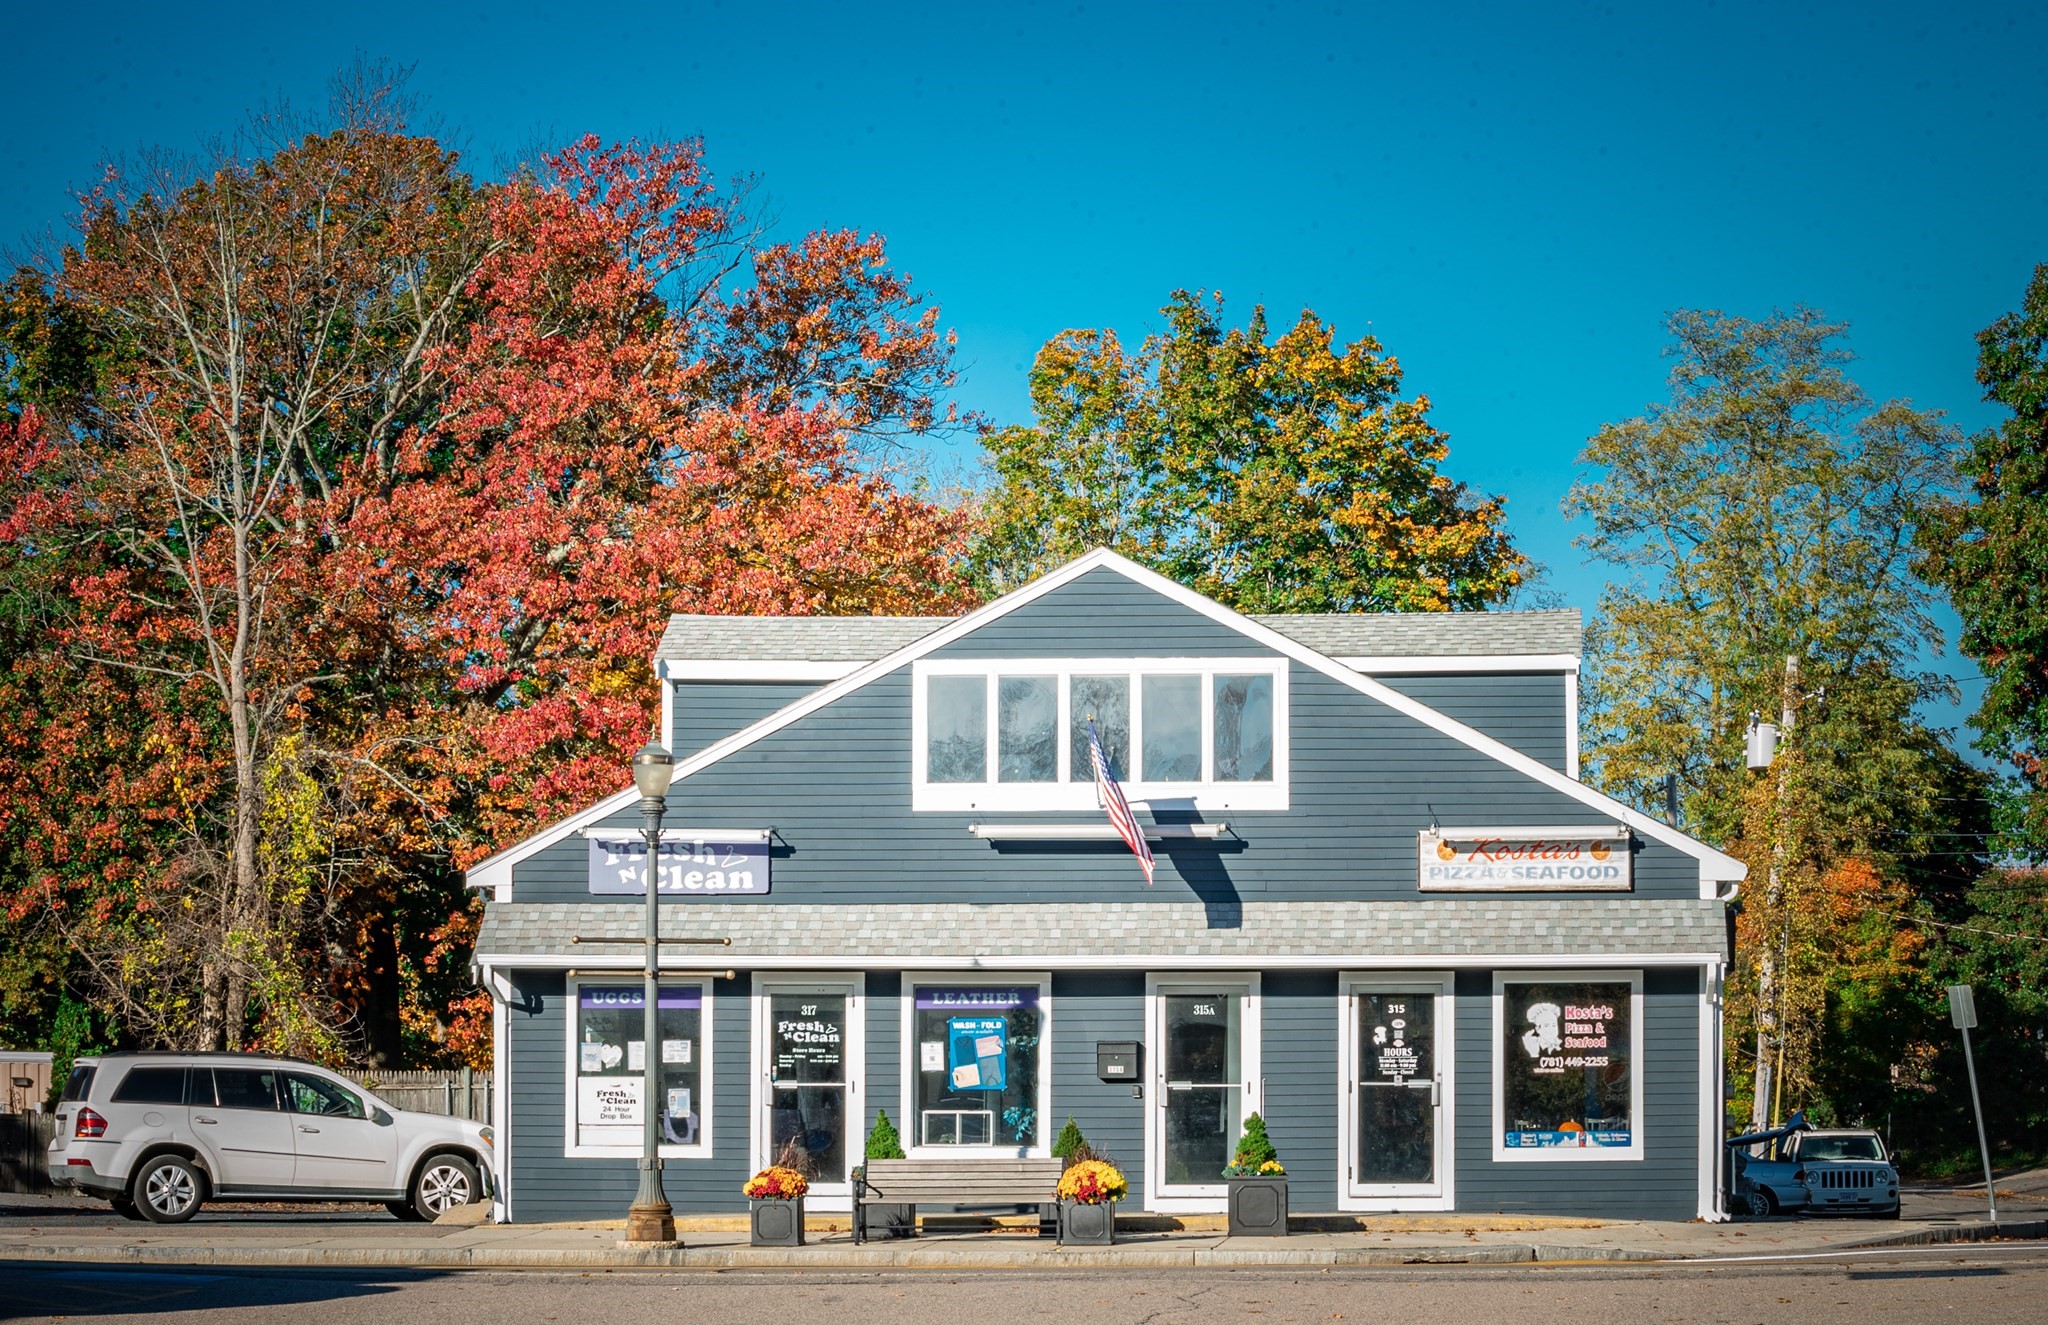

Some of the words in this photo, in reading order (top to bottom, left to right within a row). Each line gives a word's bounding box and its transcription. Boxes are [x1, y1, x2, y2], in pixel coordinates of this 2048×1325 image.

[605, 839, 716, 866] Fresh
[1467, 837, 1581, 863] Kosta's
[618, 865, 637, 884] N
[641, 865, 754, 890] Clean
[1429, 866, 1496, 881] PIZZA
[1497, 866, 1506, 879] &
[1511, 866, 1619, 881] SEAFOOD
[592, 992, 642, 1004] UGGS
[932, 992, 1021, 1005] LEATHER
[801, 1004, 817, 1016] 317
[1193, 1004, 1216, 1016] 315A
[1388, 1004, 1405, 1014] 315
[1565, 1005, 1613, 1020] Kosta's
[778, 1020, 825, 1033] Fresh
[952, 1021, 976, 1029] WASH
[981, 1021, 1003, 1029] FOLD
[1565, 1022, 1593, 1034] Pizza
[1595, 1022, 1605, 1034] &
[792, 1031, 840, 1043] Clean
[1564, 1036, 1607, 1048] Seafood
[1383, 1047, 1413, 1057] HOURS
[1540, 1057, 1564, 1068] (781)
[1564, 1056, 1609, 1067] 449-2255
[597, 1089, 627, 1098] Fresh
[606, 1097, 637, 1105] Clean
